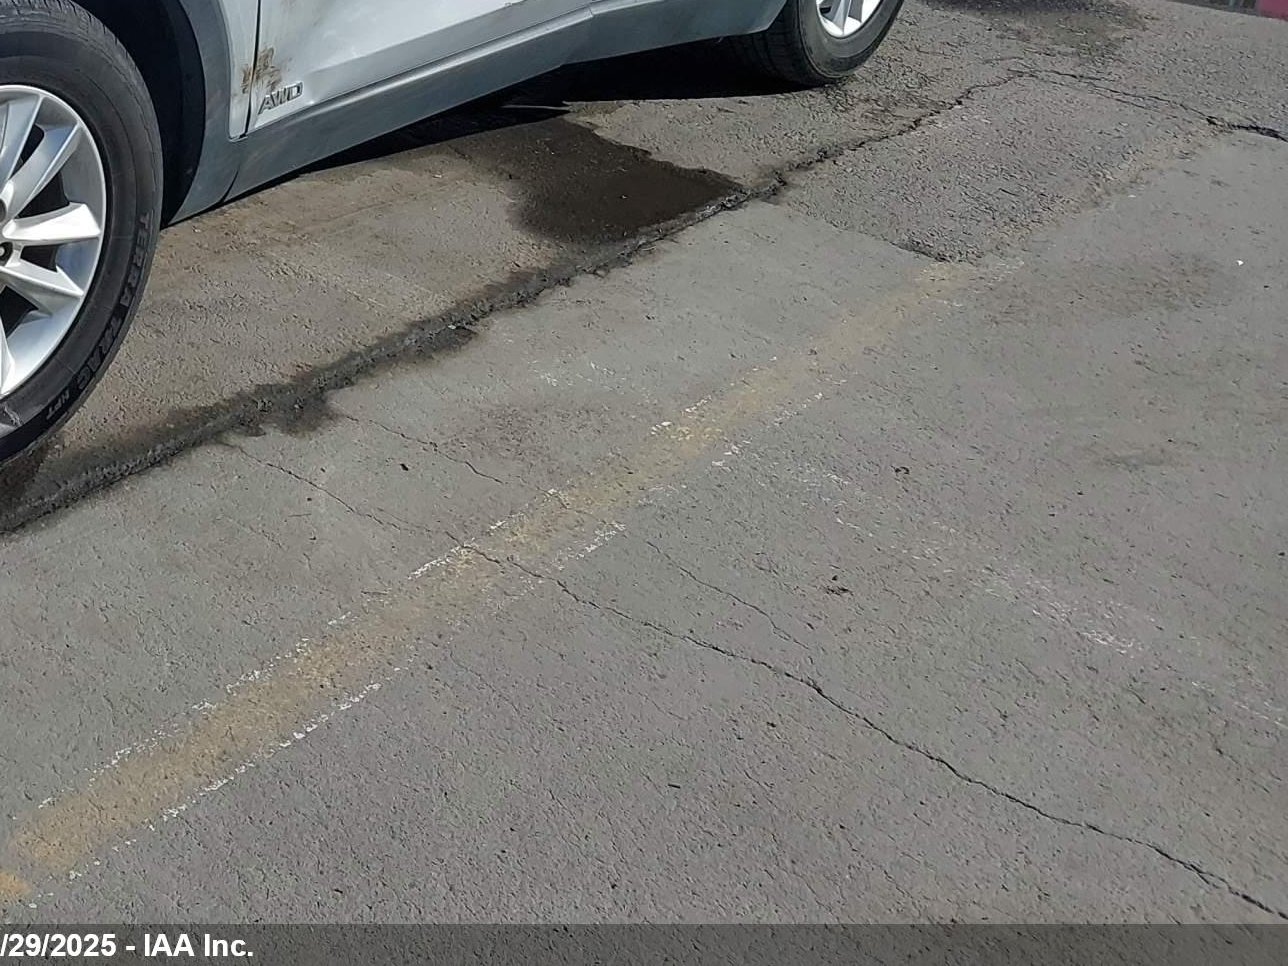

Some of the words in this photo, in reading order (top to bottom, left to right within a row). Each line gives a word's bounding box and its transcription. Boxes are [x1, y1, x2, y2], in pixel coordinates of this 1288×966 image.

[257, 81, 304, 115] AWD
[119, 210, 151, 308] TERRA
[76, 314, 123, 391] TRAC
